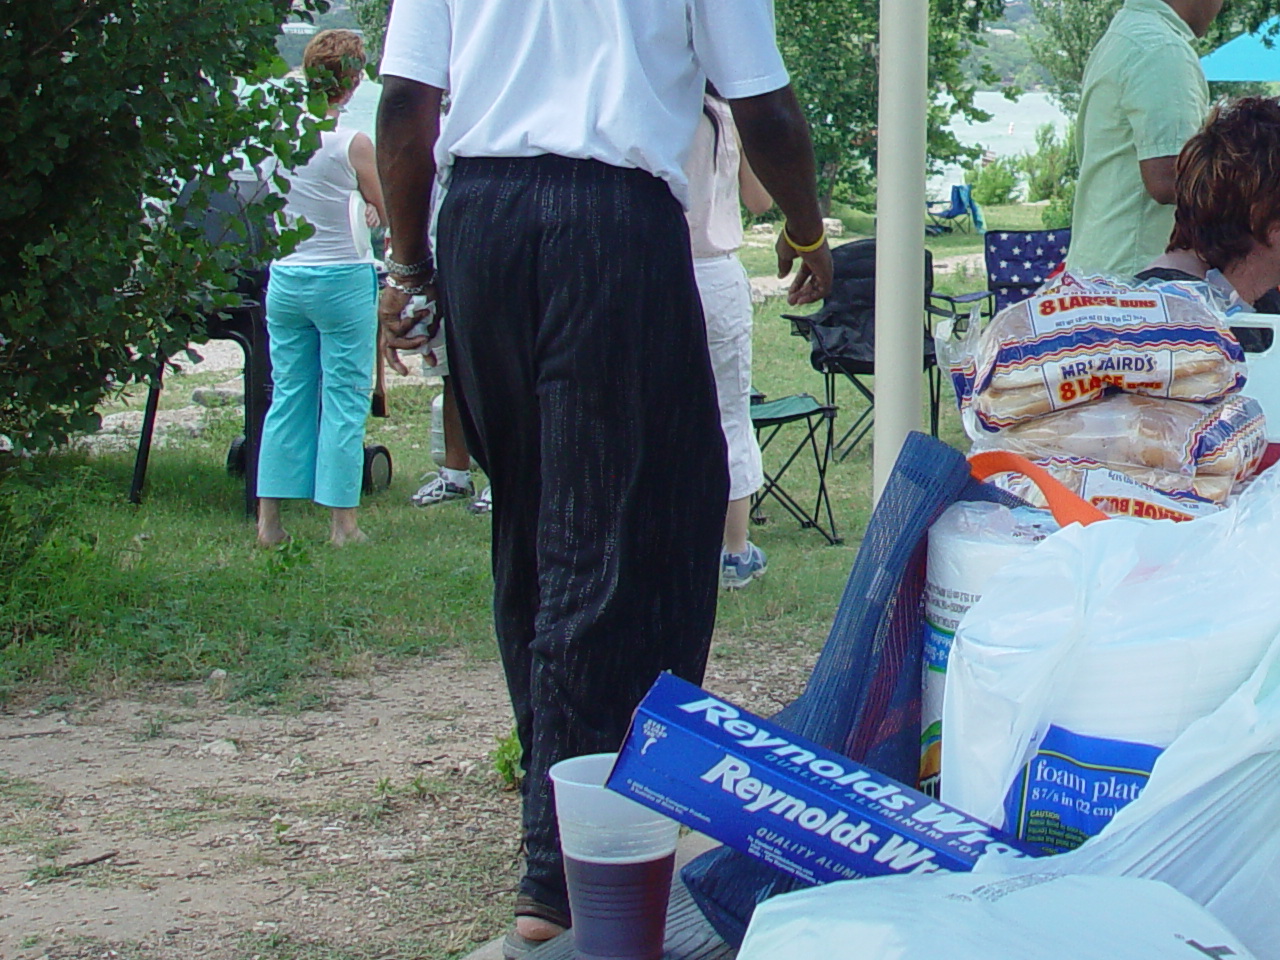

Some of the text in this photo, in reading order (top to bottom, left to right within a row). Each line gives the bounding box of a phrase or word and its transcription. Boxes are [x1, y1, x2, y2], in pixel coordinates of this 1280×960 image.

[1039, 295, 1158, 316] 8 LARGE BUNS
[1058, 380, 1077, 403] 8
[1078, 374, 1125, 397] LAGE
[1090, 495, 1130, 514] BUS
[677, 696, 915, 811] Reynolds
[911, 802, 1040, 858] Wra
[1035, 759, 1086, 795] foam
[700, 753, 880, 855] Reynolds
[764, 754, 981, 858] QUALITY ALUMINUM FOI
[1031, 787, 1040, 800] 8
[1061, 792, 1073, 807] in
[1093, 804, 1118, 817] cm)
[756, 827, 816, 859] QUALITY
[815, 855, 867, 881] ALUMI
